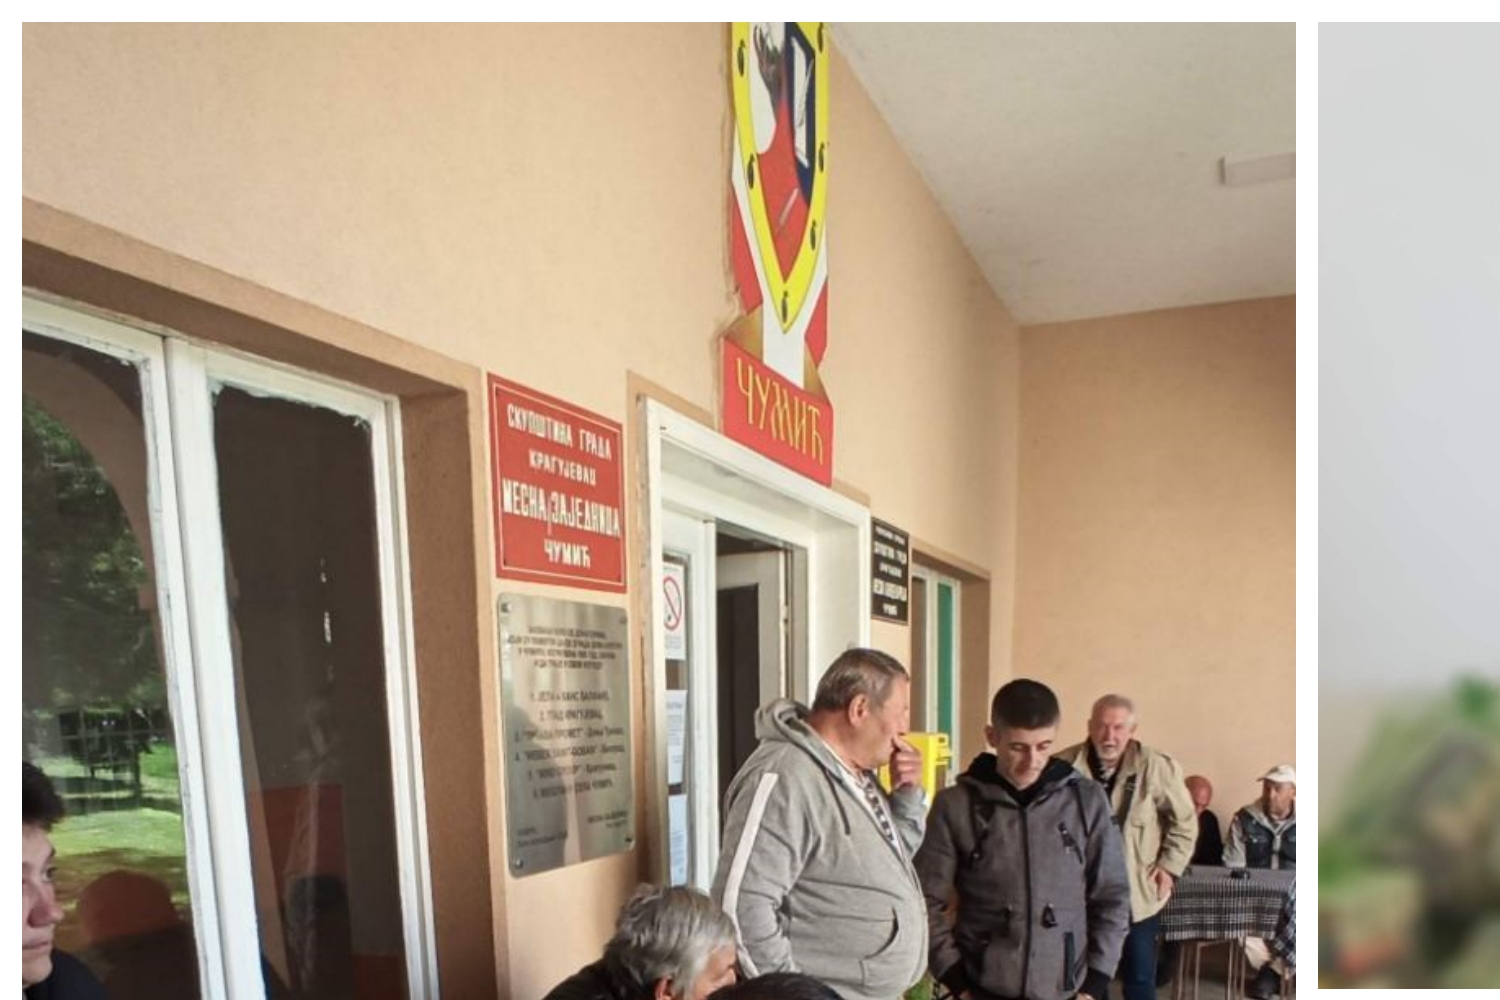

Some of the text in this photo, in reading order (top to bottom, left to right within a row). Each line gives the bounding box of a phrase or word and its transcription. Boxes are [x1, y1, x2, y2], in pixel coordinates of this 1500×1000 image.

[506, 402, 612, 460] СКУПШТИНА ГРАДА
[736, 357, 823, 466] ЧУМИЋ
[528, 448, 597, 486] КРАГУЈЕВАЦ
[502, 478, 621, 538] МЕСНА ЗАЈЕДНИЦА
[543, 538, 591, 569] ЧУМИЋ
